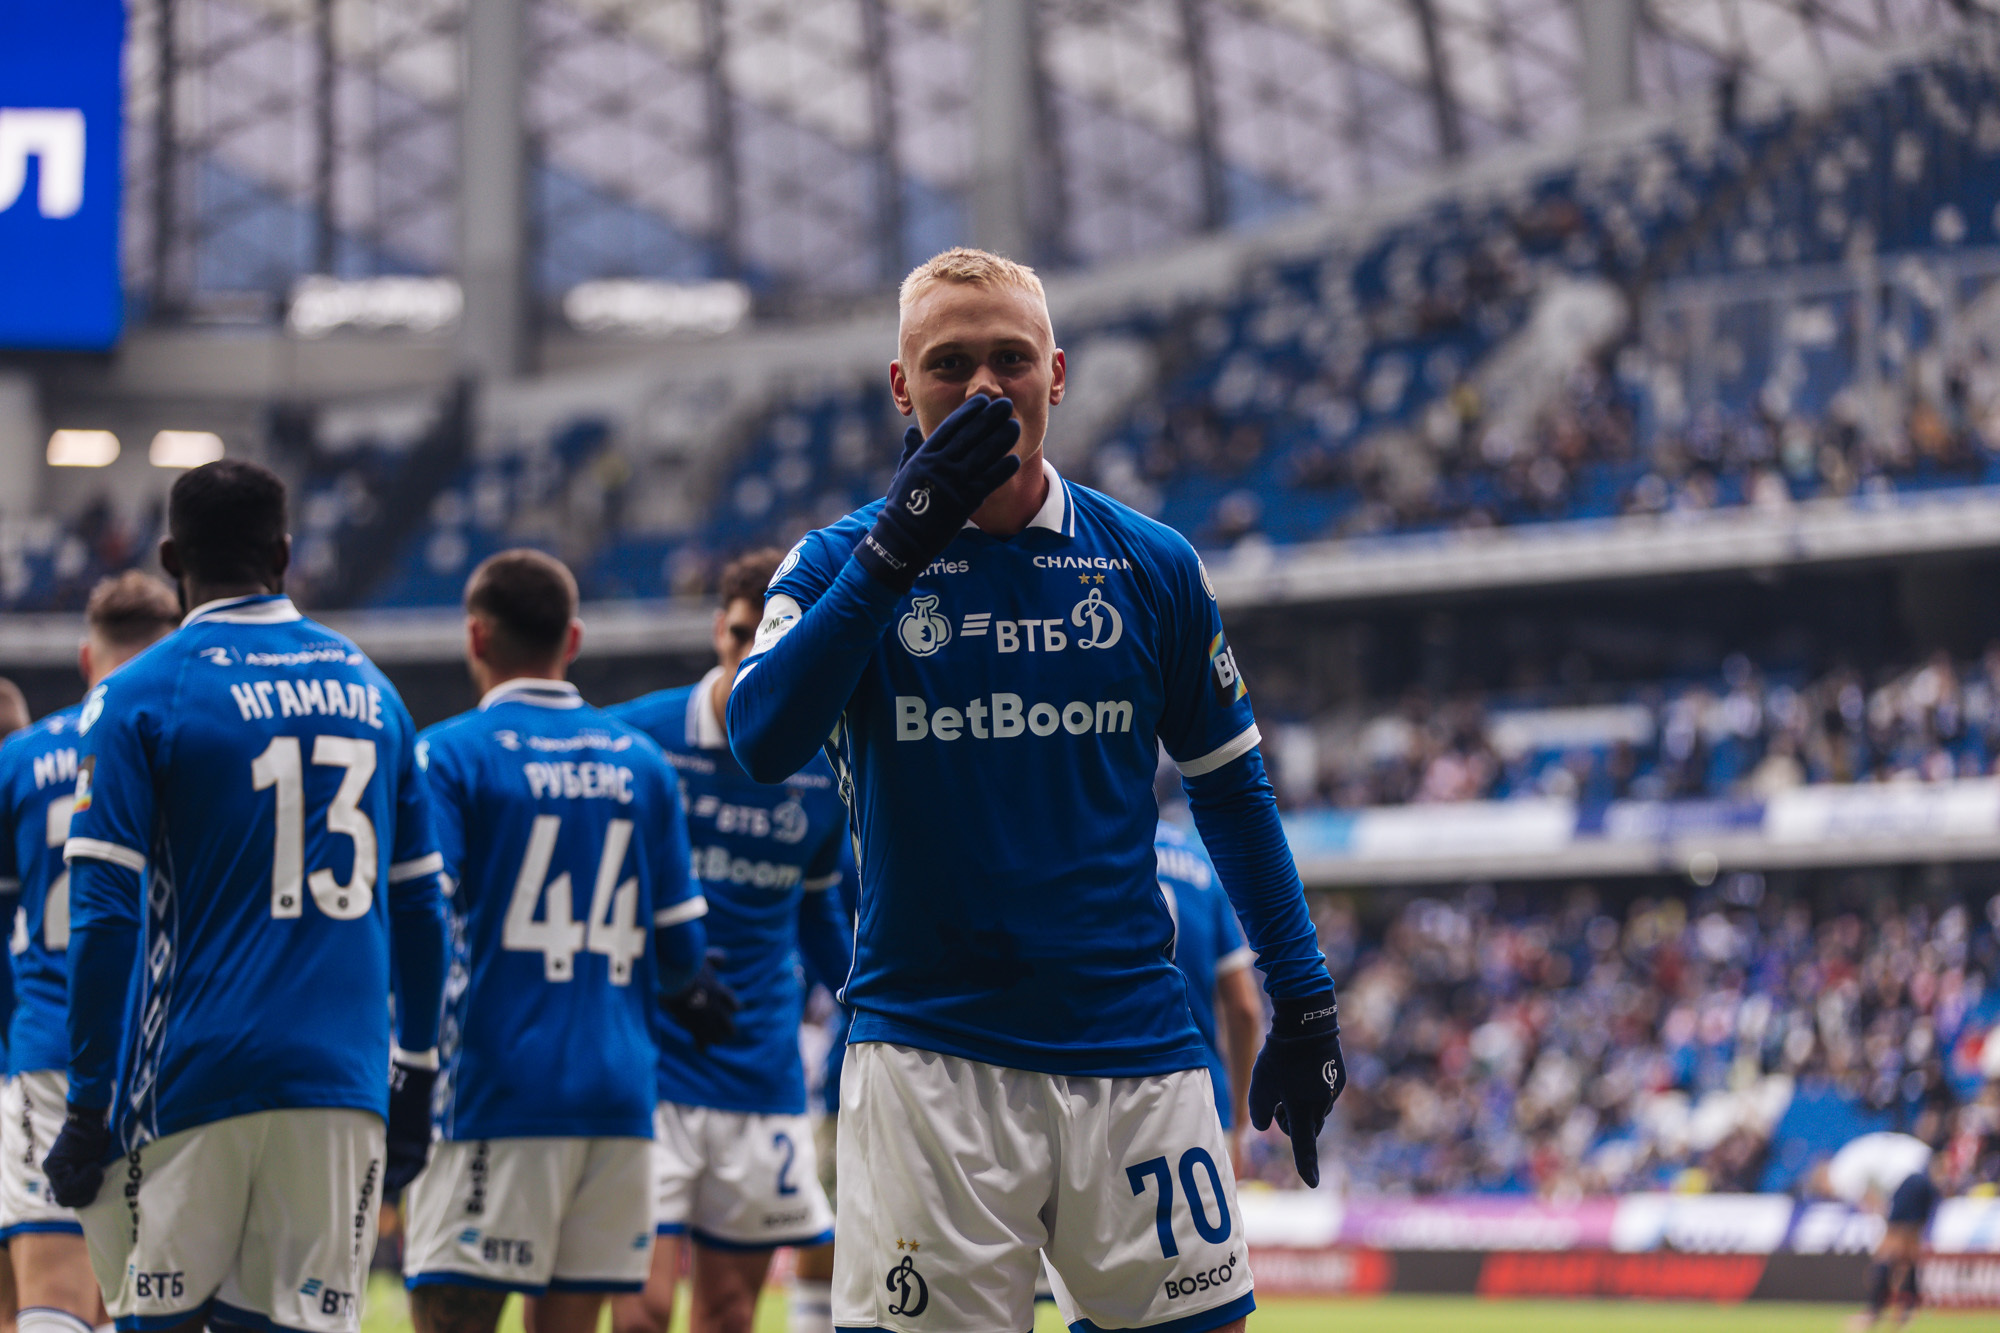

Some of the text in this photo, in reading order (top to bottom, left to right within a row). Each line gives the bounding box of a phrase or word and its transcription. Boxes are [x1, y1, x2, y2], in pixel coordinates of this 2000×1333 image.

[1032, 555, 1133, 572] CHANGAN
[995, 618, 1068, 653] ВТБ
[895, 693, 1134, 741] BetBoom
[251, 736, 378, 921] 13
[503, 814, 647, 987] 44
[772, 1131, 799, 1196] 2
[1125, 1146, 1232, 1259] 70
[137, 1272, 185, 1299] ВТБ
[1165, 1263, 1233, 1300] BOSCO
